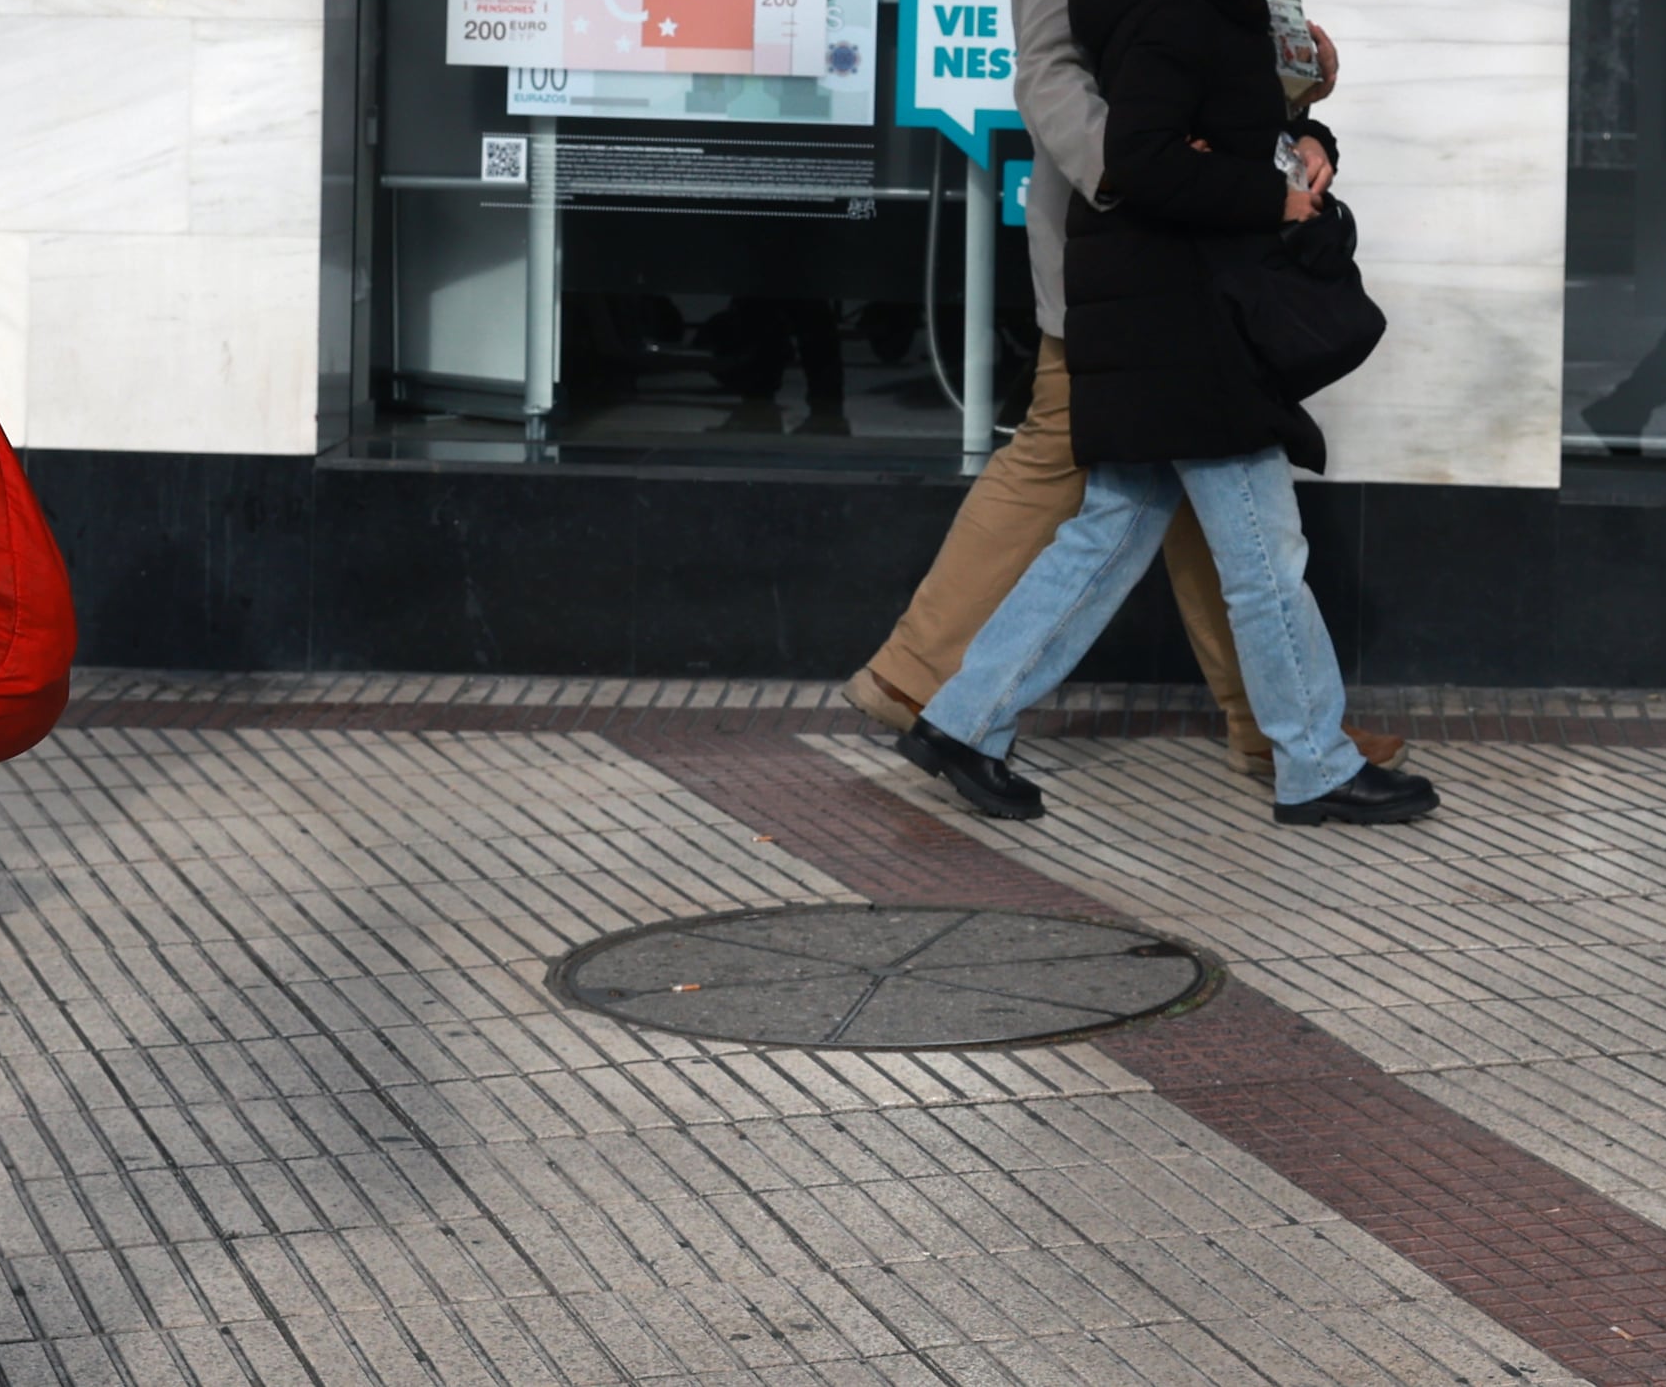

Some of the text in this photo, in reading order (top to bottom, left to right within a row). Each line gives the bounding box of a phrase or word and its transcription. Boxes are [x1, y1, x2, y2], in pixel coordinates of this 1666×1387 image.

[476, 4, 535, 14] PENSIONES
[464, 20, 547, 41] 200 EURO
[933, 4, 998, 37] VIE
[933, 46, 1019, 80] NES
[515, 68, 568, 91] 100
[514, 94, 567, 104] EURAZOS
